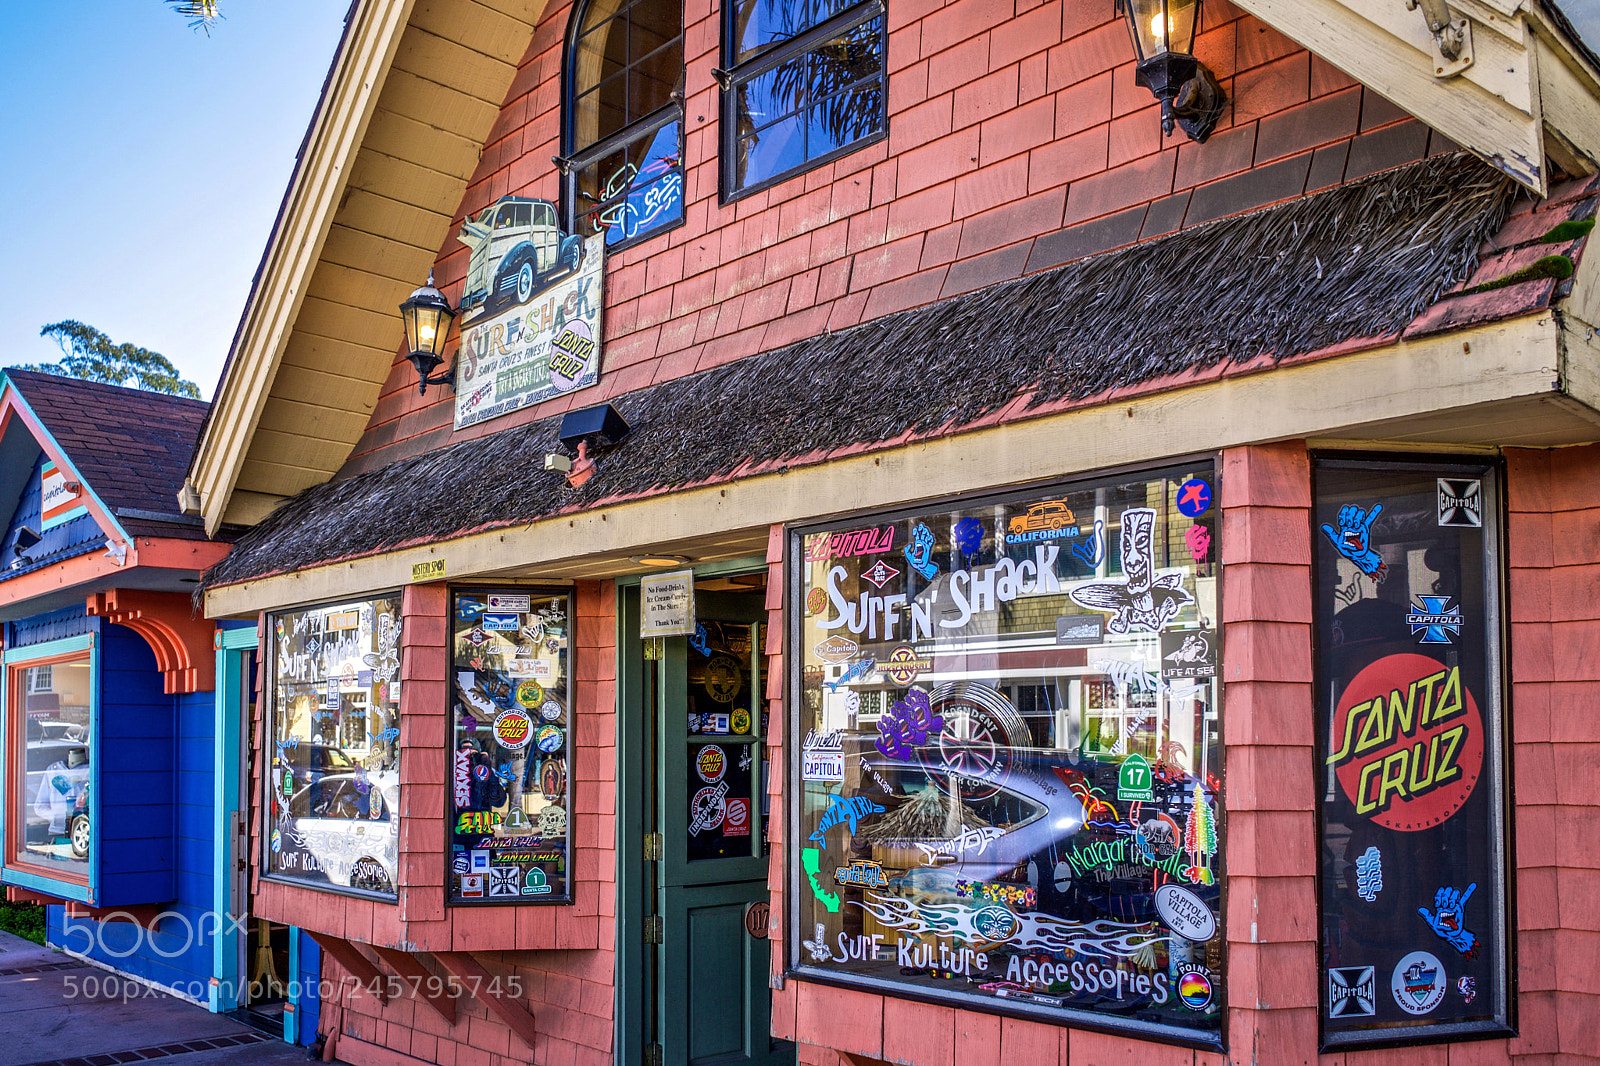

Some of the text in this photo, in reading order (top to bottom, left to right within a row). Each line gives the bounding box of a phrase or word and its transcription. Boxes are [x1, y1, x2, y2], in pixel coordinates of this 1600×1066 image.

[464, 316, 521, 381] SURF
[524, 276, 596, 343] SHACK
[552, 329, 594, 359] SANTA
[478, 361, 497, 378] SANTA
[549, 352, 584, 381] CRUZ
[1440, 491, 1480, 512] CAPITOLA
[1006, 526, 1080, 544] CALIFORNIA
[804, 526, 894, 562] CAPITOLA
[431, 559, 445, 572] SPOT
[1408, 616, 1460, 624] CAPITOLA
[826, 644, 856, 654] Capitola
[1162, 666, 1215, 677] LIFE AT SEA
[712, 692, 734, 702] PRIDE
[495, 718, 529, 728] SANTA
[496, 710, 527, 723] AUTHORIZED
[1326, 666, 1464, 766] SANTA
[498, 728, 526, 738] CRUZ
[698, 754, 723, 764] SANTA
[700, 763, 721, 773] CRUZ
[805, 762, 842, 776] CAPITOLA
[1127, 768, 1144, 785] 17
[1356, 726, 1466, 816] CRUZ
[1013, 760, 1058, 796] The Village
[691, 784, 726, 832] INDEPENDENT
[1386, 774, 1476, 829] SKATEBOARDS
[511, 810, 522, 826] 1
[475, 836, 542, 848] SANTA CRUZ
[494, 852, 561, 862] SANTA CRUZ
[533, 875, 538, 884] 1
[1094, 863, 1148, 882] The Village
[1167, 898, 1201, 929] VILLAGE
[1169, 889, 1207, 923] CAPITOLA
[752, 909, 769, 931] 117
[1171, 918, 1184, 930] 1874
[1179, 964, 1210, 976] POINT
[1332, 980, 1372, 1003] CAPITOLA
[1395, 986, 1445, 1011] PROUD SPONSOR
